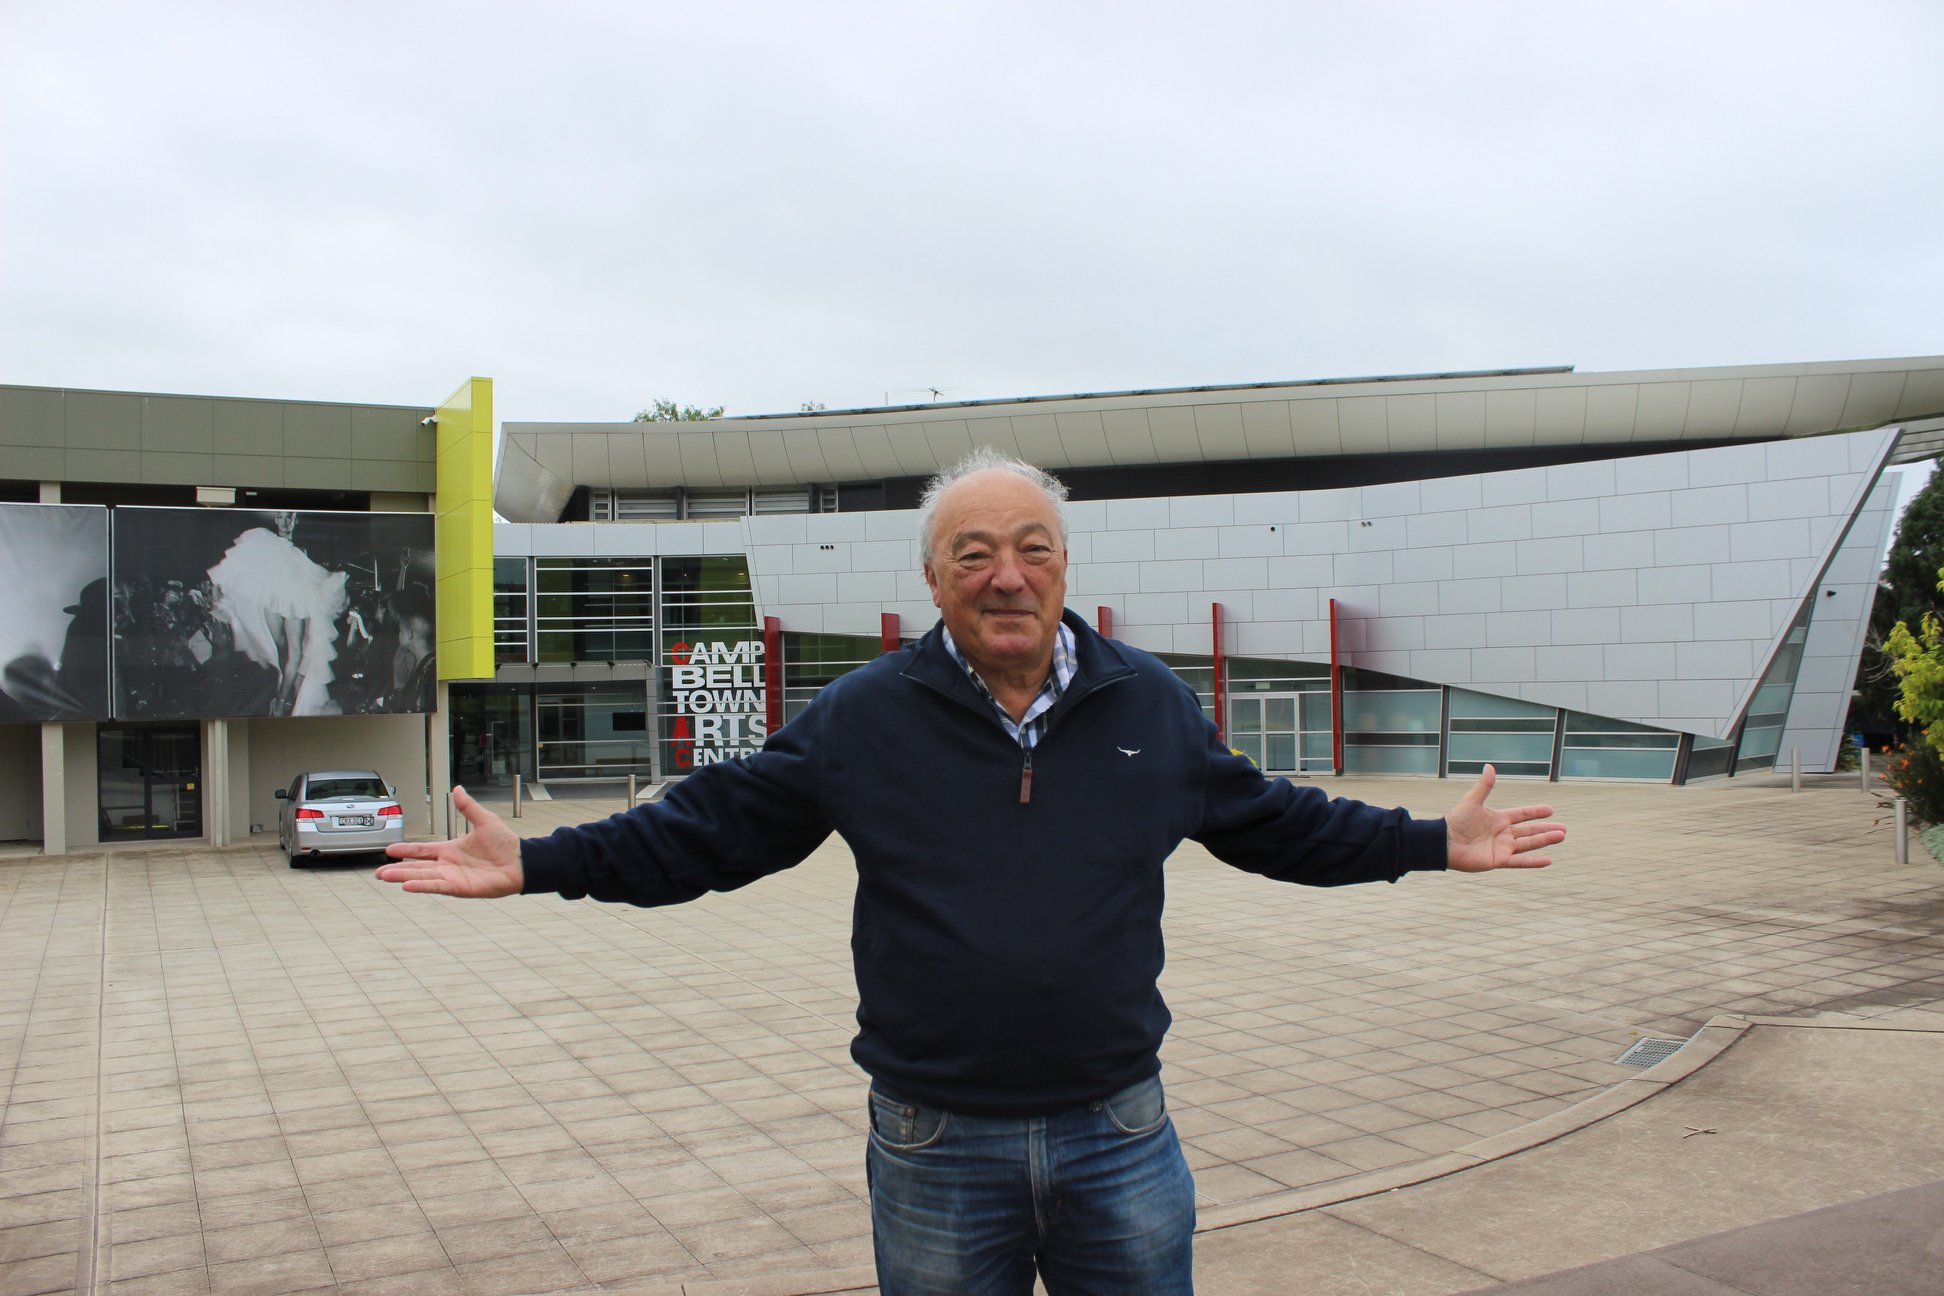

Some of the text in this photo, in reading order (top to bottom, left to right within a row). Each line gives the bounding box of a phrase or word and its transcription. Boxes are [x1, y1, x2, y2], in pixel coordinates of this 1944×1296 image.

[672, 641, 765, 665] CAMP
[672, 665, 766, 688] BELL
[672, 690, 766, 713] TOWN
[672, 715, 767, 746] ARTS
